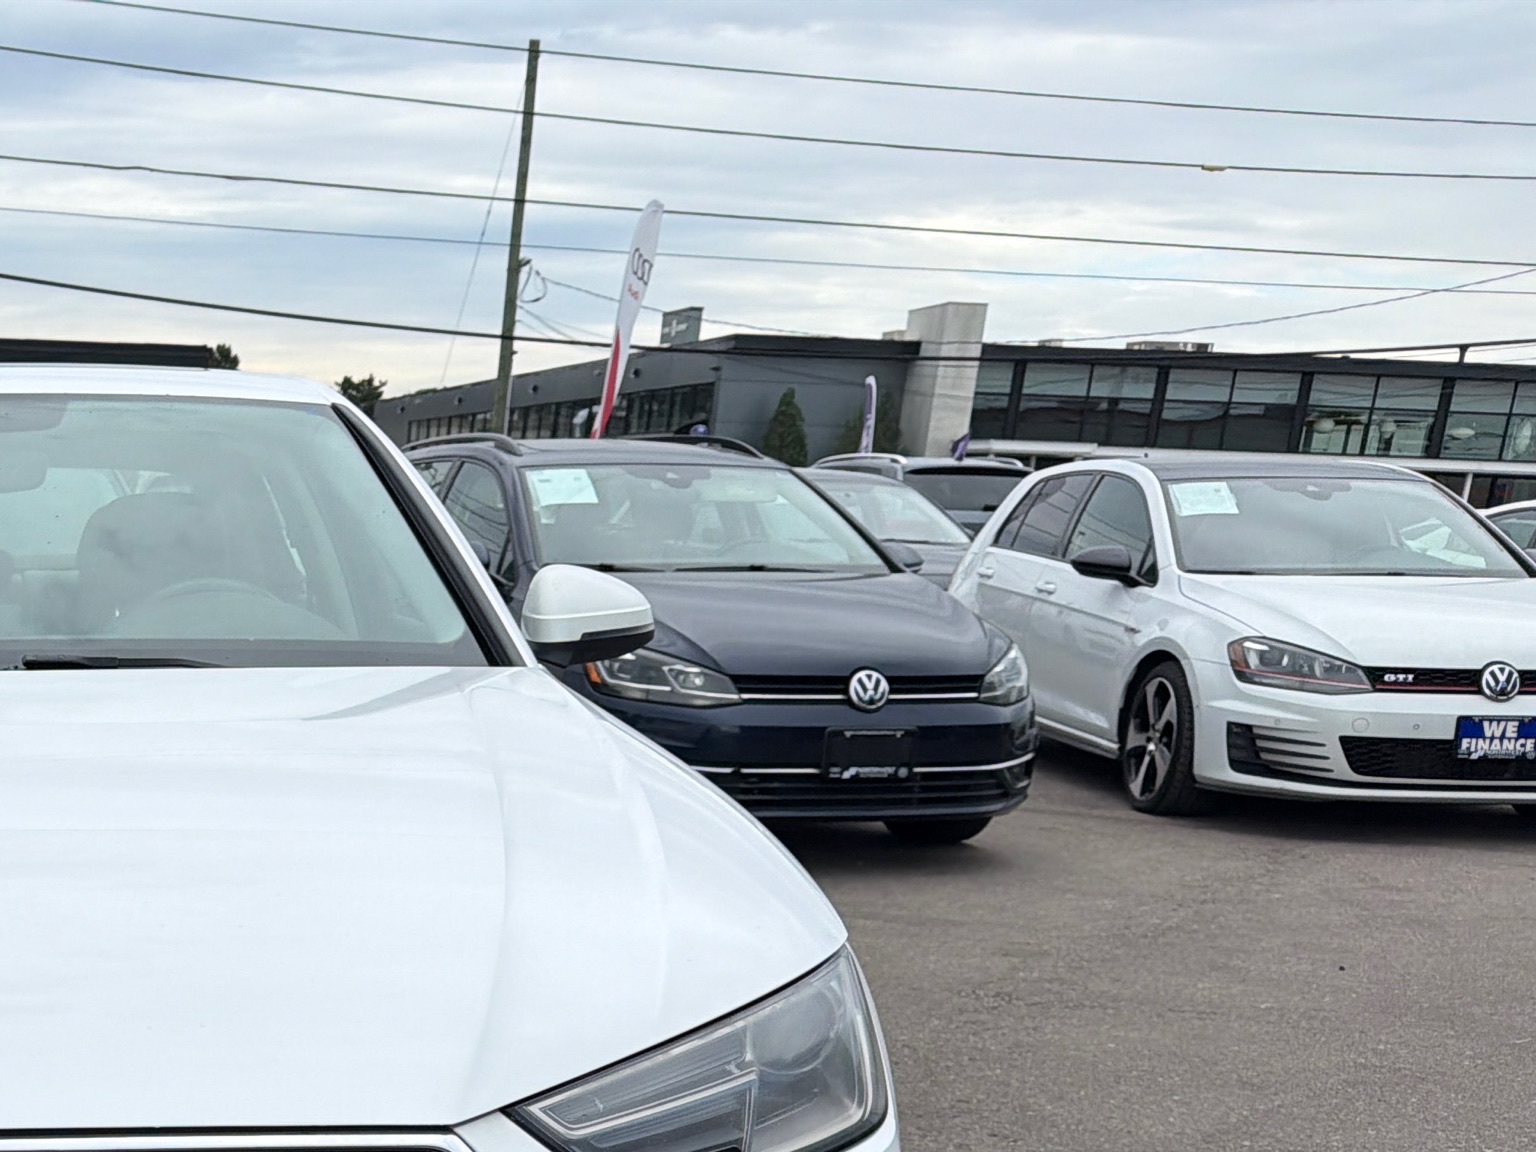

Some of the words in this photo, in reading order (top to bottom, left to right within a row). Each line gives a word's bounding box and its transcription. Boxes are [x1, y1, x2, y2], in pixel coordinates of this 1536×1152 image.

[1383, 673, 1415, 683] GTI
[1482, 720, 1520, 738] WE
[1461, 737, 1536, 753] FINANCE
